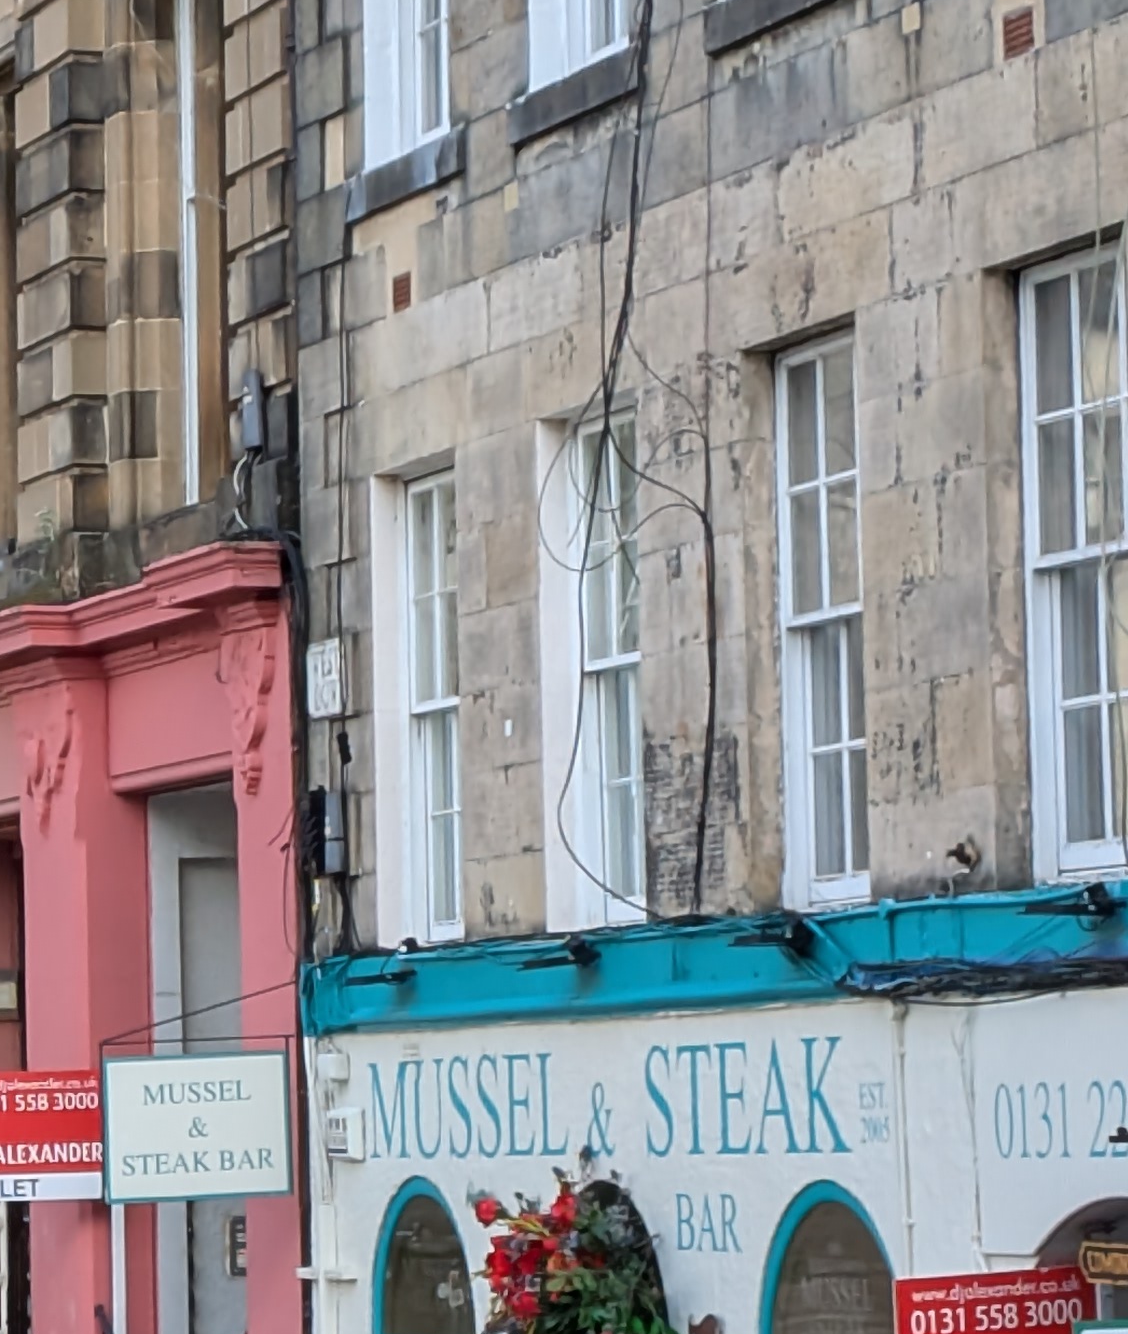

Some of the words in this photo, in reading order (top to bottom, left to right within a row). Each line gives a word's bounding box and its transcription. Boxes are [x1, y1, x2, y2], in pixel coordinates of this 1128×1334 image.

[15, 1093, 49, 1112] 558
[52, 1092, 99, 1110] 3000
[142, 1079, 252, 1106] MUSSEL
[368, 1052, 569, 1160] MUSSEL
[586, 1081, 616, 1159] &
[644, 1035, 853, 1158] STEAK
[188, 1116, 209, 1139] &
[993, 1081, 1071, 1159] 0131
[121, 1150, 212, 1177] STEAK
[219, 1147, 275, 1172] BAR
[0, 1178, 40, 1198] LET
[674, 1192, 743, 1254] BAR
[975, 1302, 1019, 1332] 558
[1024, 1297, 1083, 1328] 3000
